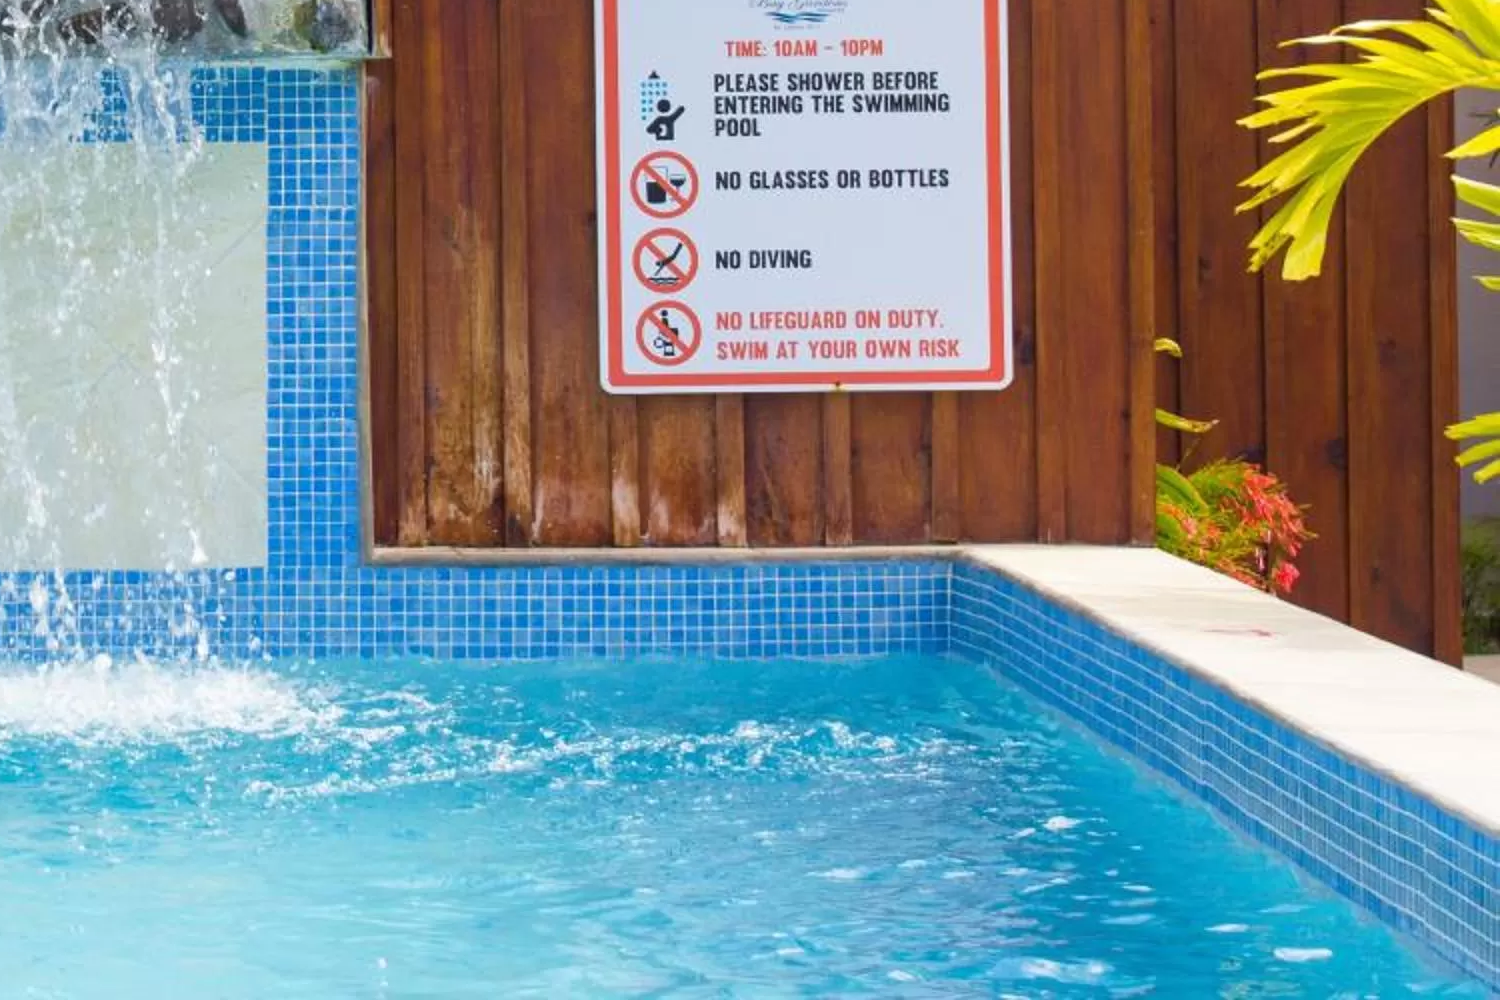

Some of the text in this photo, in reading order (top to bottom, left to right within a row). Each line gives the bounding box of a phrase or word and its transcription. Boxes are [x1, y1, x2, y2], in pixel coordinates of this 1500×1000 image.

[724, 41, 767, 57] TIME:
[774, 41, 818, 57] 10AM
[840, 39, 883, 56] 10PM
[714, 72, 938, 92] PLEASE SHOWER BEFORE
[714, 93, 950, 115] ENTERING THE SWIMMING
[715, 119, 761, 137] POOL
[716, 169, 949, 190] NO GLASSES OR BOTTLES
[716, 250, 812, 269] NO DIVING
[716, 309, 944, 331] NO LIFEGUARD ON DUTY.
[717, 339, 959, 360] SWIM AT YOUR OWN RISK
